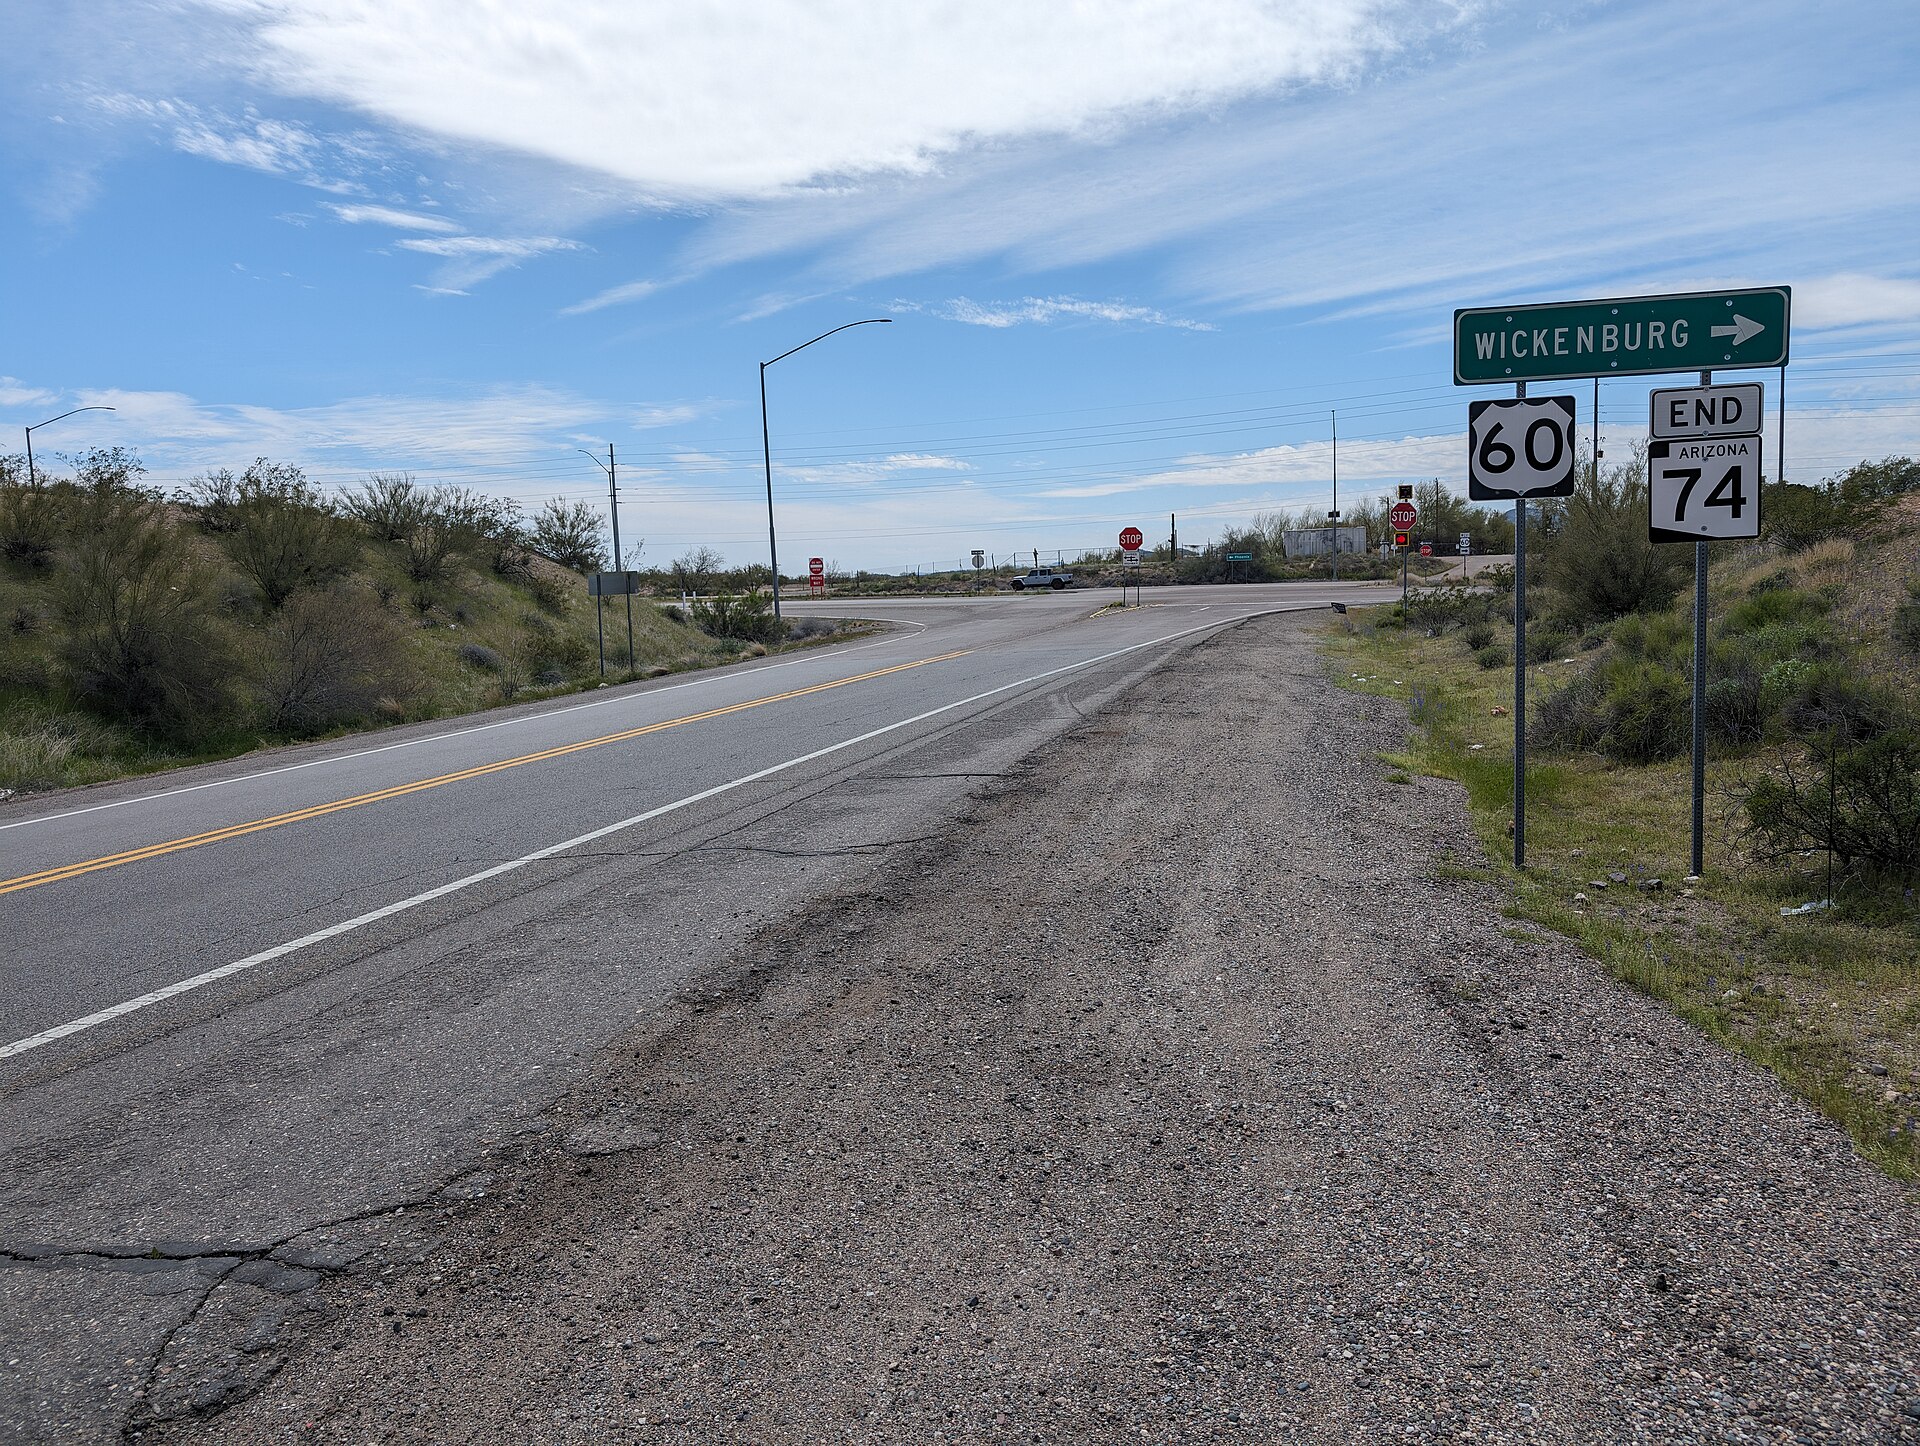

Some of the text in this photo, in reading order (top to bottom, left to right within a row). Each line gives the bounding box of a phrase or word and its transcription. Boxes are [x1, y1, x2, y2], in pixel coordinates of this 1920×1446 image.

[1475, 319, 1689, 360] WICKENBURG
[1670, 396, 1743, 427] END
[1479, 418, 1564, 474] 60
[1679, 443, 1749, 460] ARIZONA
[1663, 466, 1747, 522] 74
[1391, 511, 1416, 522] STOP
[1121, 534, 1141, 544] STOP
